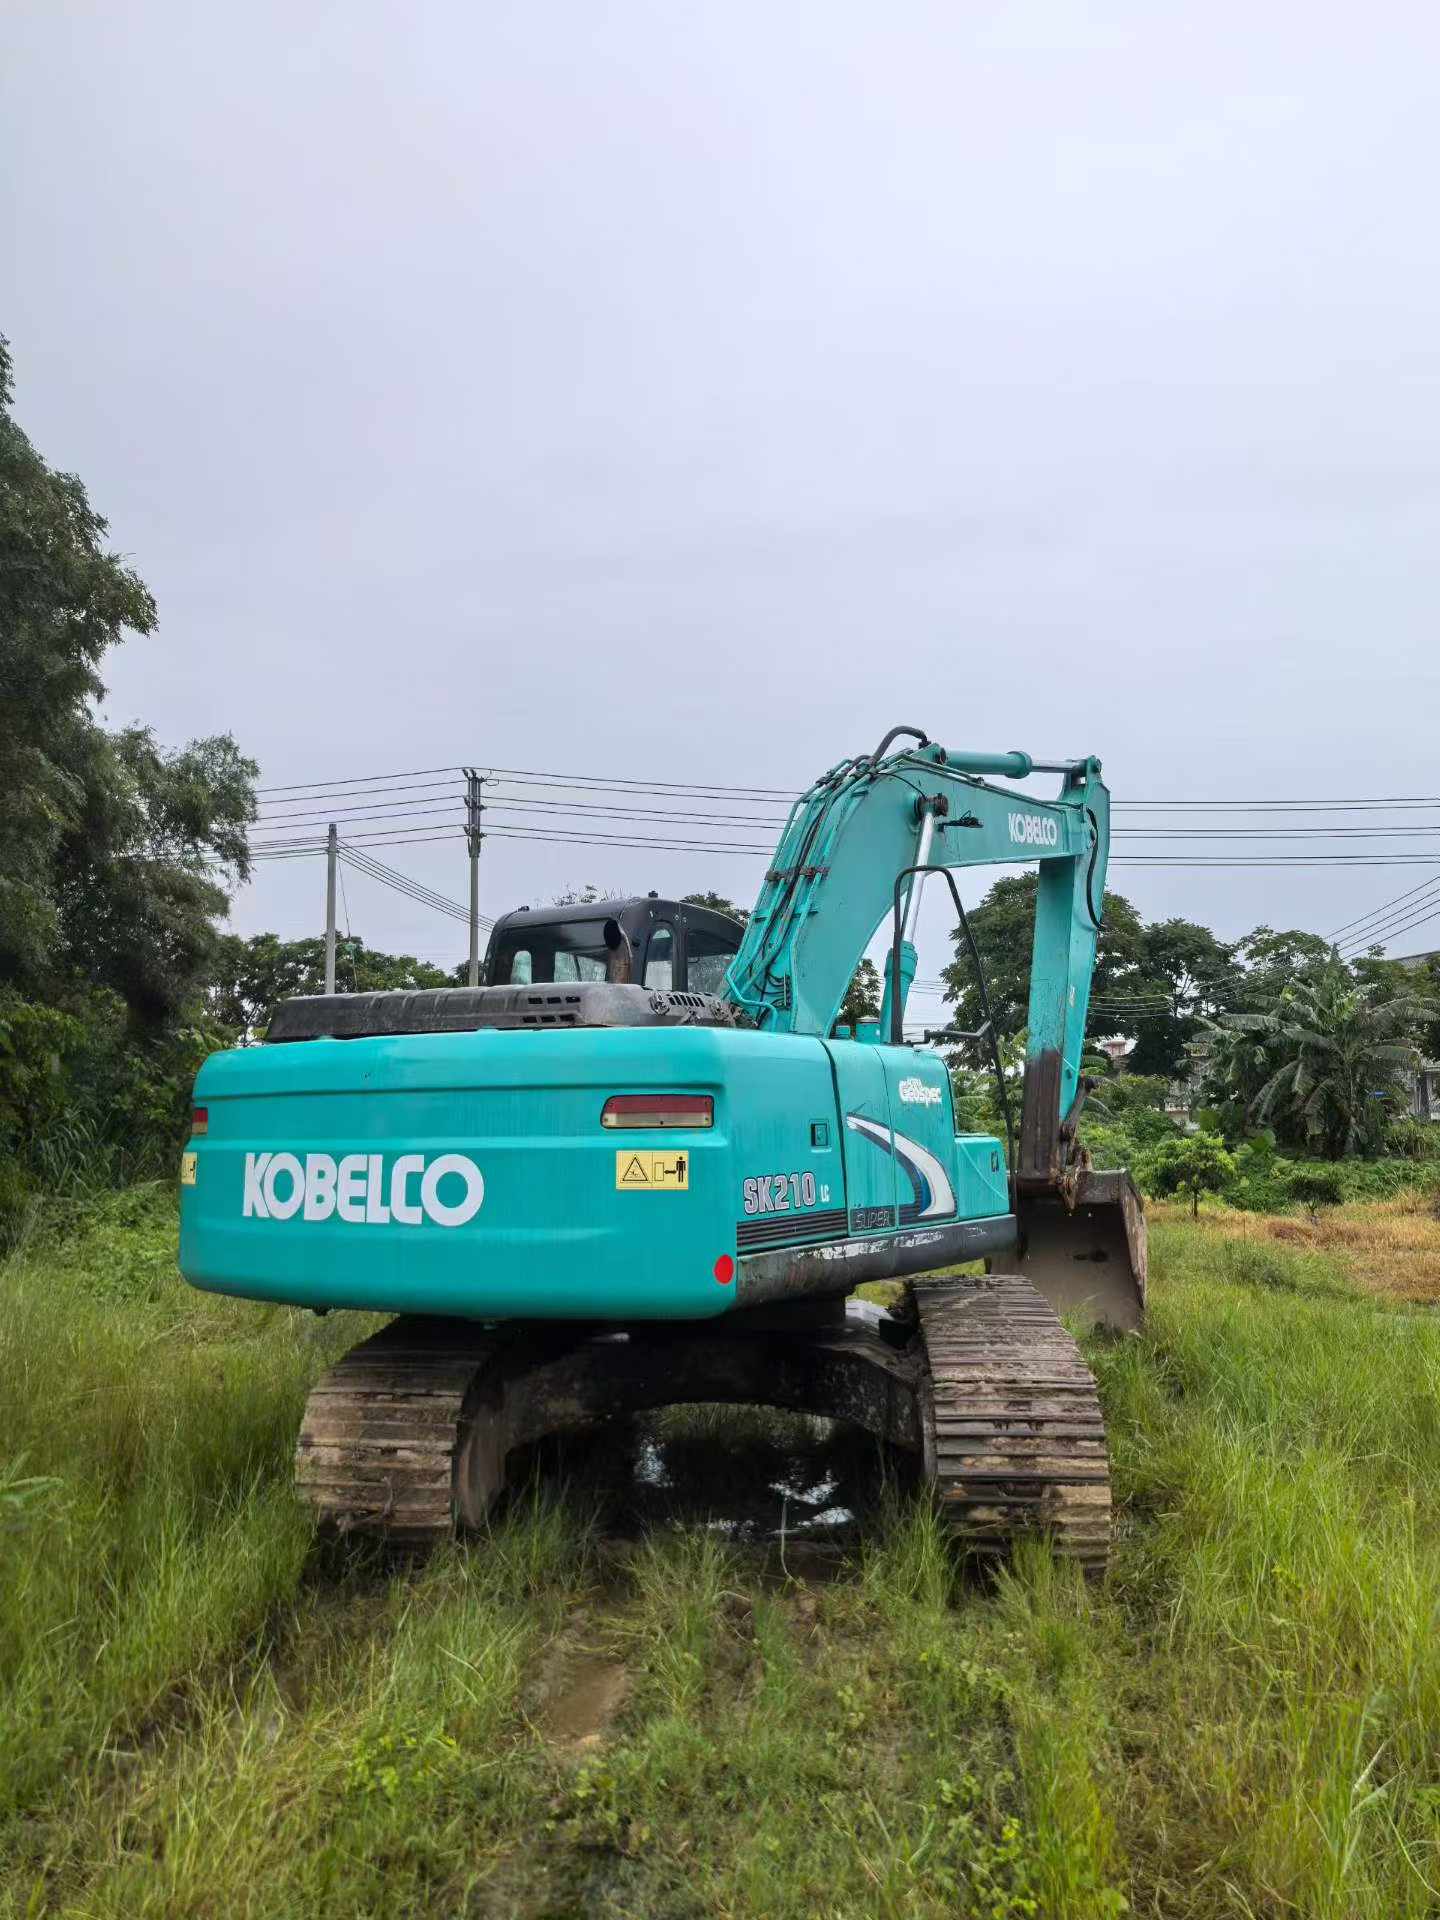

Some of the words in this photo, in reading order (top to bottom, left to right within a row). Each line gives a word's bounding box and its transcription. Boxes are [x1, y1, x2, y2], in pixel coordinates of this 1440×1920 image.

[1008, 813, 1057, 846] KOBELCO
[242, 1152, 485, 1227] KOBELCO
[743, 1172, 816, 1214] SK210
